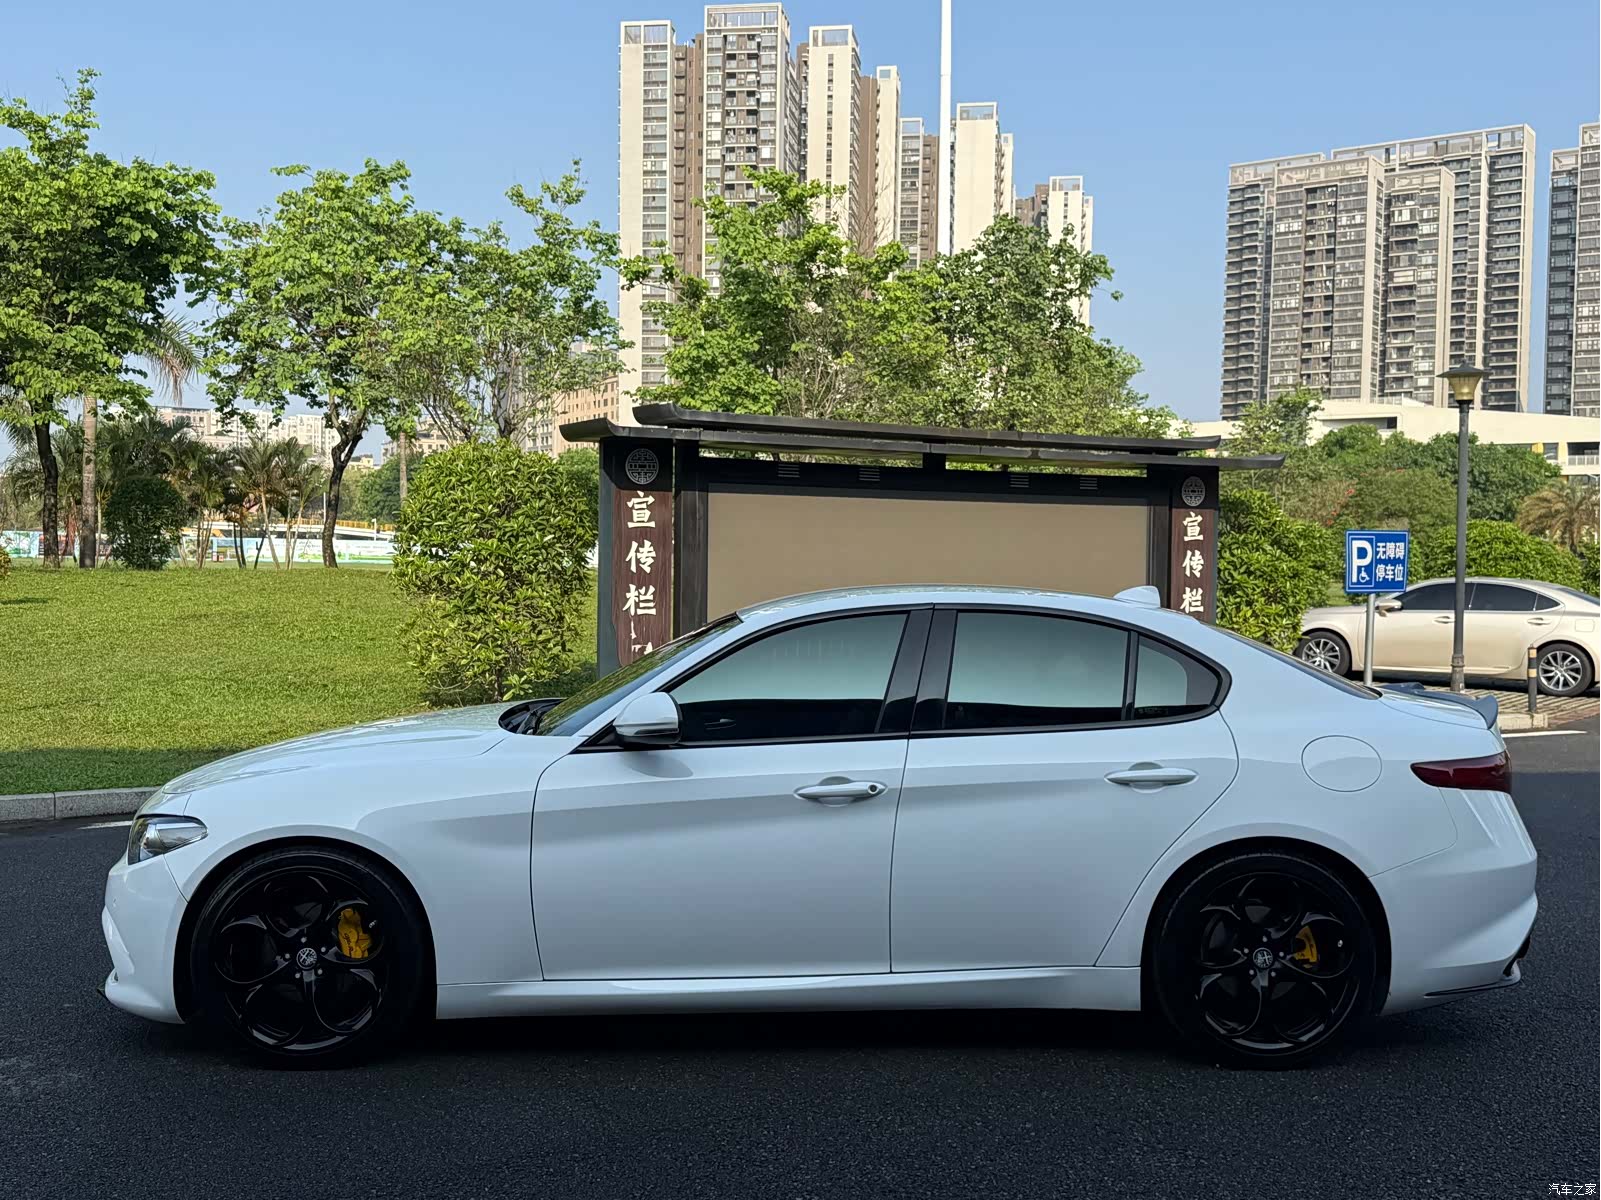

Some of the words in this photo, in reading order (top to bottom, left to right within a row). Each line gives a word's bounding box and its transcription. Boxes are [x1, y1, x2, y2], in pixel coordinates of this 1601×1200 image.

[622, 491, 657, 616] 宣传栏
[1180, 511, 1205, 614] 宣传栏
[1351, 540, 1373, 583] P
[1376, 542, 1405, 560] 无障碍
[1376, 563, 1404, 582] 停车位
